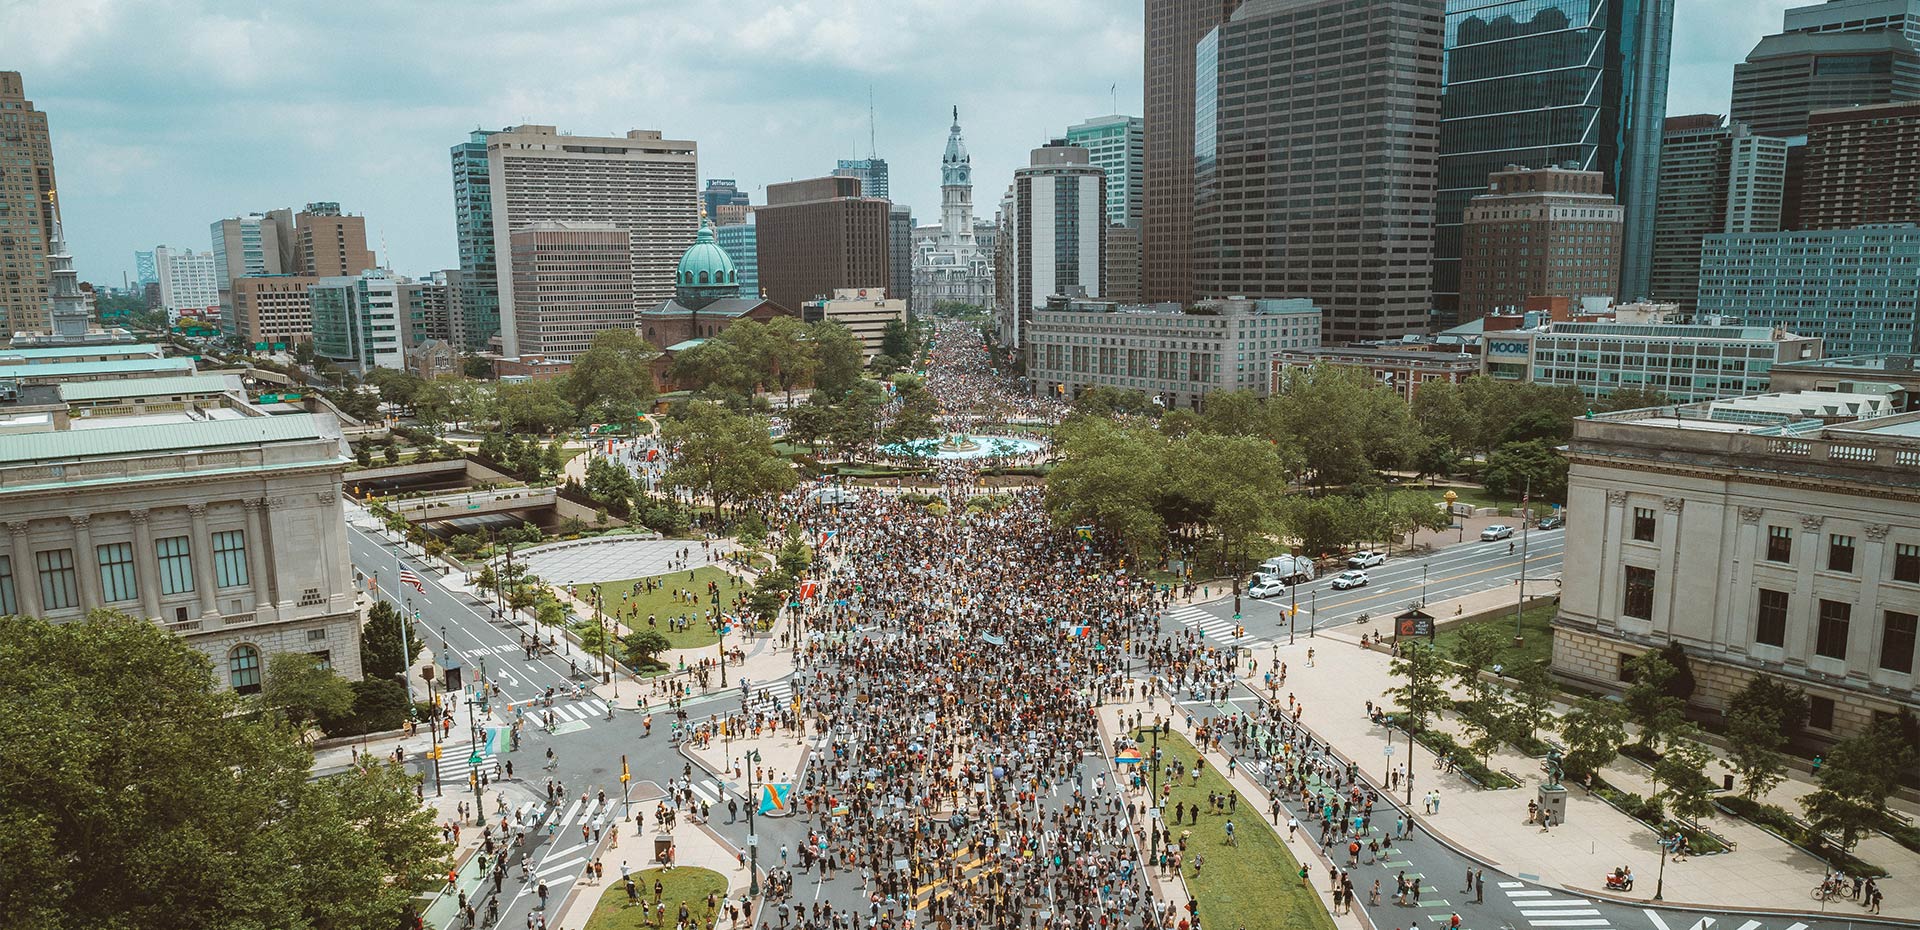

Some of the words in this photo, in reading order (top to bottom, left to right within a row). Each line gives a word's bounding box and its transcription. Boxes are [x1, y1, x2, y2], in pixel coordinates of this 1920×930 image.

[1490, 342, 1529, 353] MOORE
[296, 599, 327, 607] LIBRARY
[462, 647, 491, 658] ONLY
[492, 644, 520, 653] ONLY
